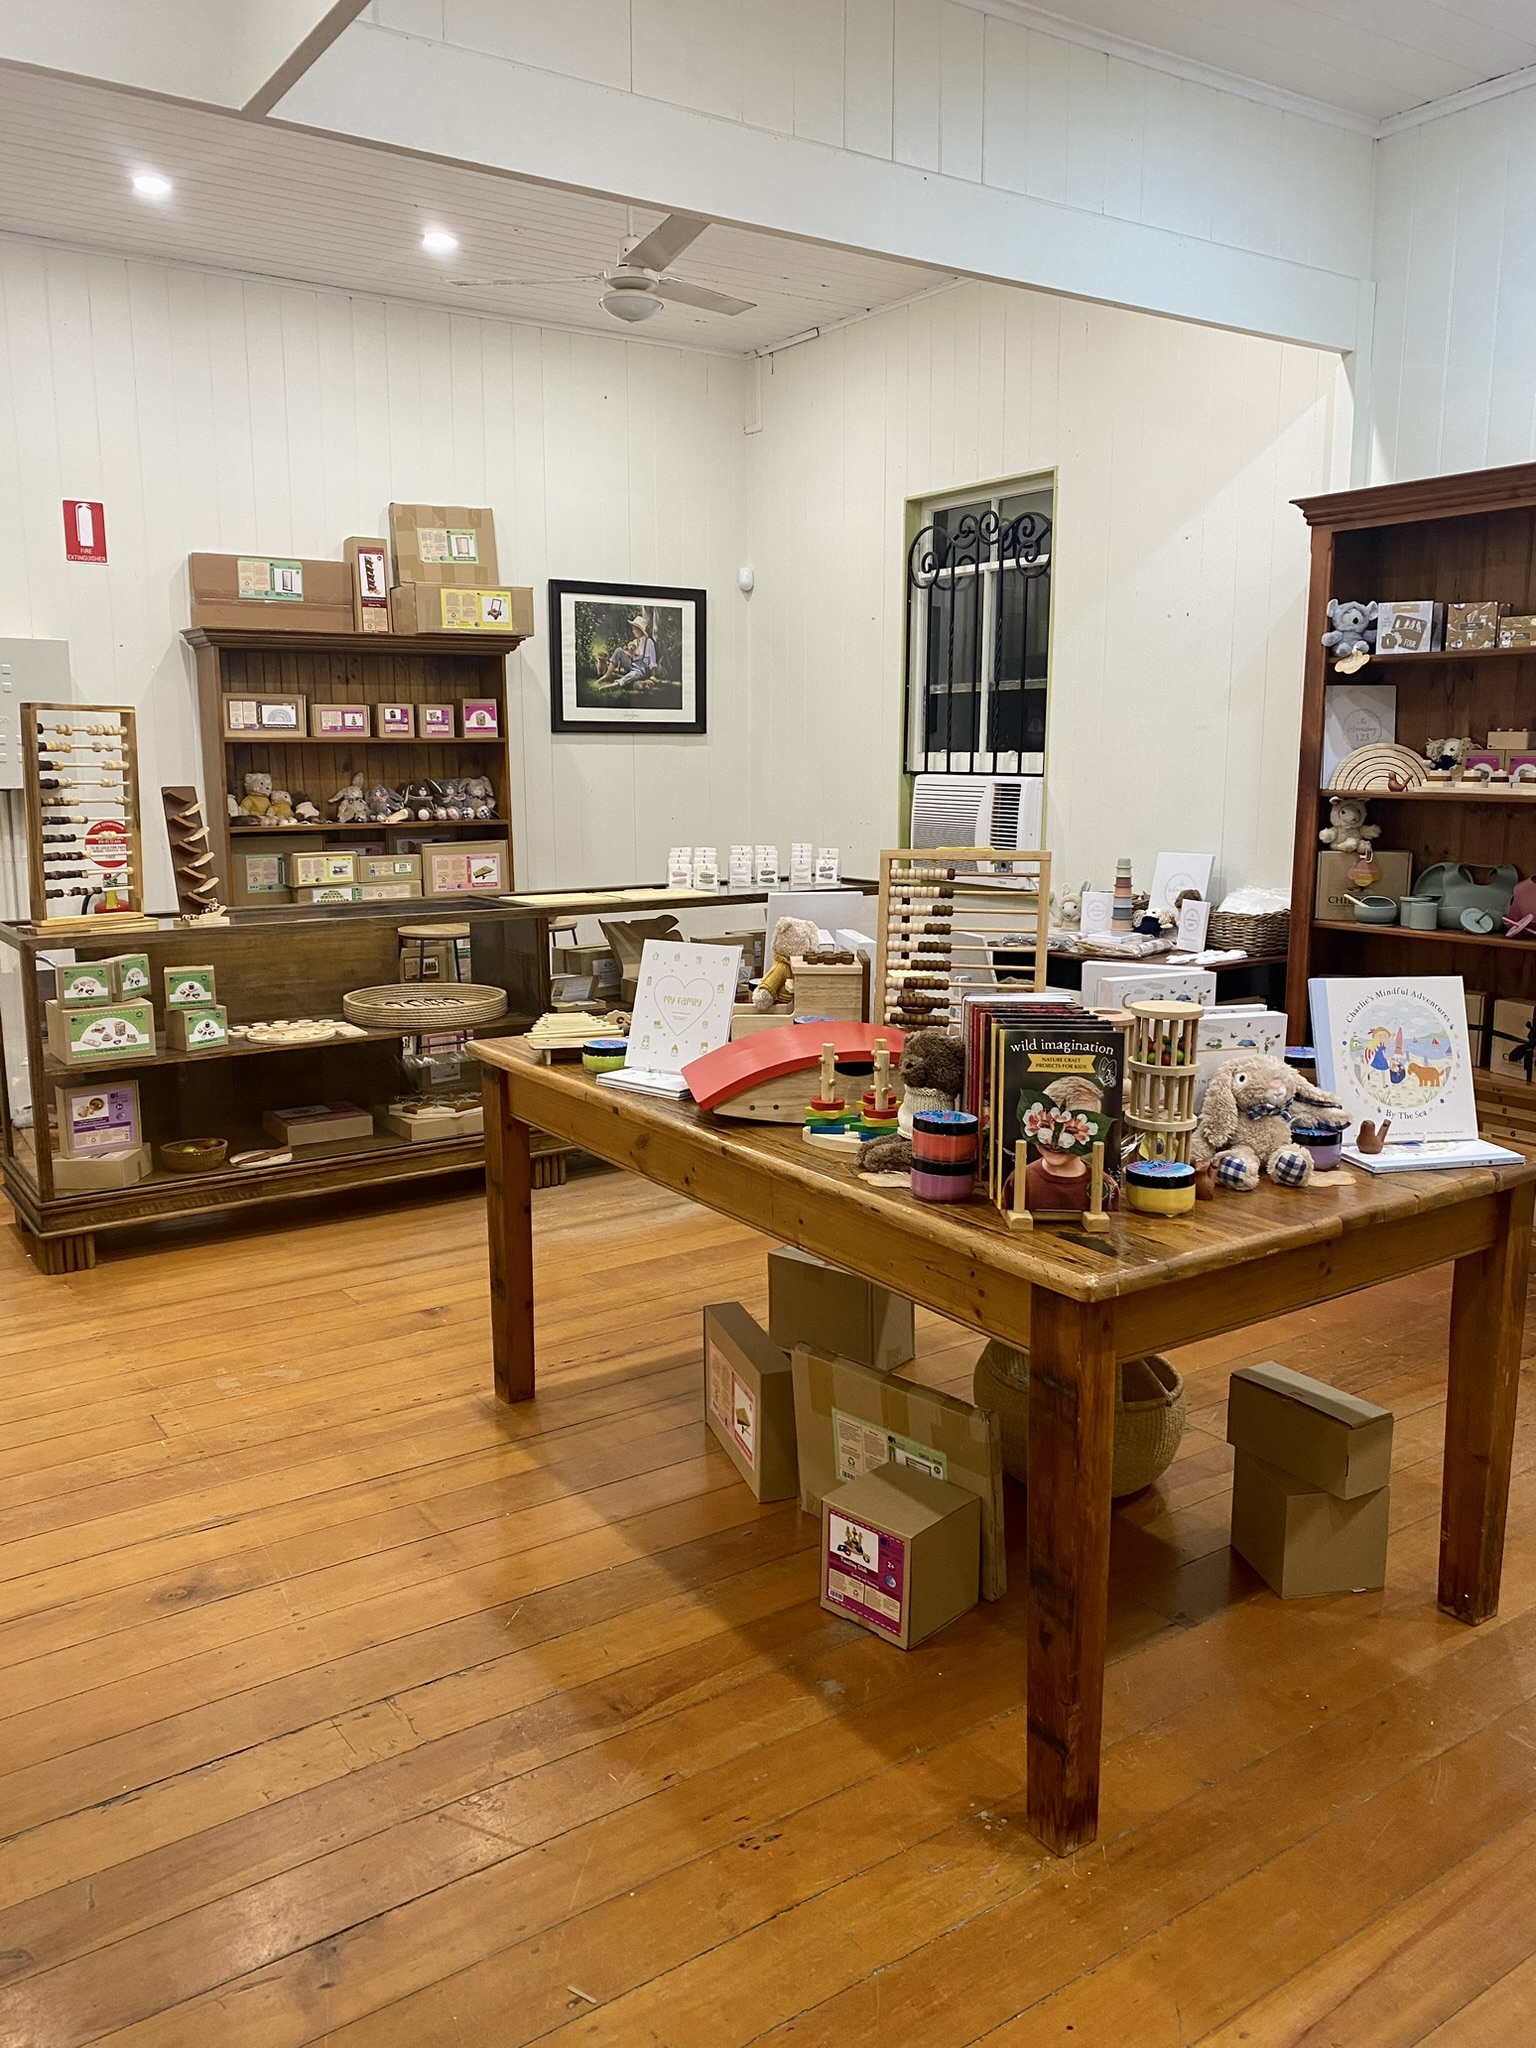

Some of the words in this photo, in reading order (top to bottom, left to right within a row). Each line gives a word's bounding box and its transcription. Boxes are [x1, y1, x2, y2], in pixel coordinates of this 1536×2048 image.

[67, 554, 107, 562] EXTINGUISHER
[1403, 638, 1417, 648] FOUR
[1346, 995, 1375, 1023] Charlie's
[1375, 987, 1409, 999] Mindful
[1410, 990, 1452, 1023] Adventures
[1010, 1038, 1037, 1052] wild
[1041, 1039, 1114, 1055] imagination
[1385, 1109, 1396, 1120] By
[1398, 1111, 1414, 1120] The
[1414, 1110, 1428, 1119] Sea
[1501, 1107, 1507, 1115] 8
[1510, 1130, 1516, 1138] 6
